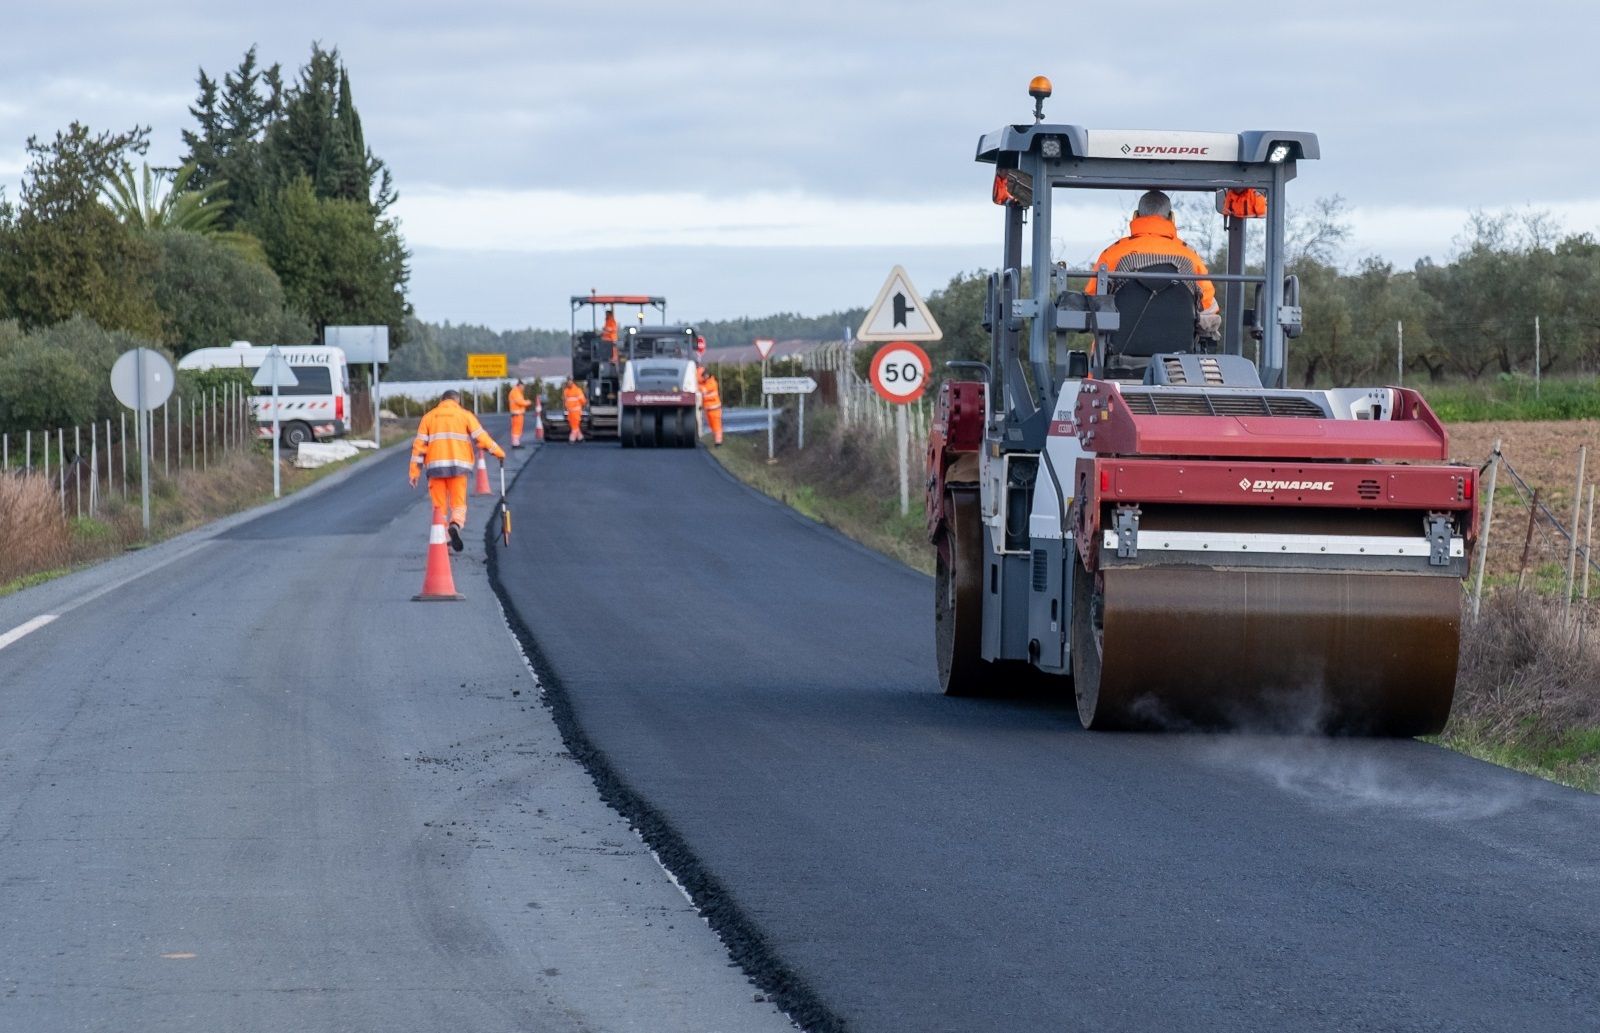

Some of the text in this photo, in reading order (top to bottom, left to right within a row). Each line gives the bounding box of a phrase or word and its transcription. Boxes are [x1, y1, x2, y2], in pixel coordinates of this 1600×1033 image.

[1133, 145, 1209, 155] DYNAPAC
[885, 363, 917, 382] 50
[1252, 480, 1335, 491] DYNAPAC
